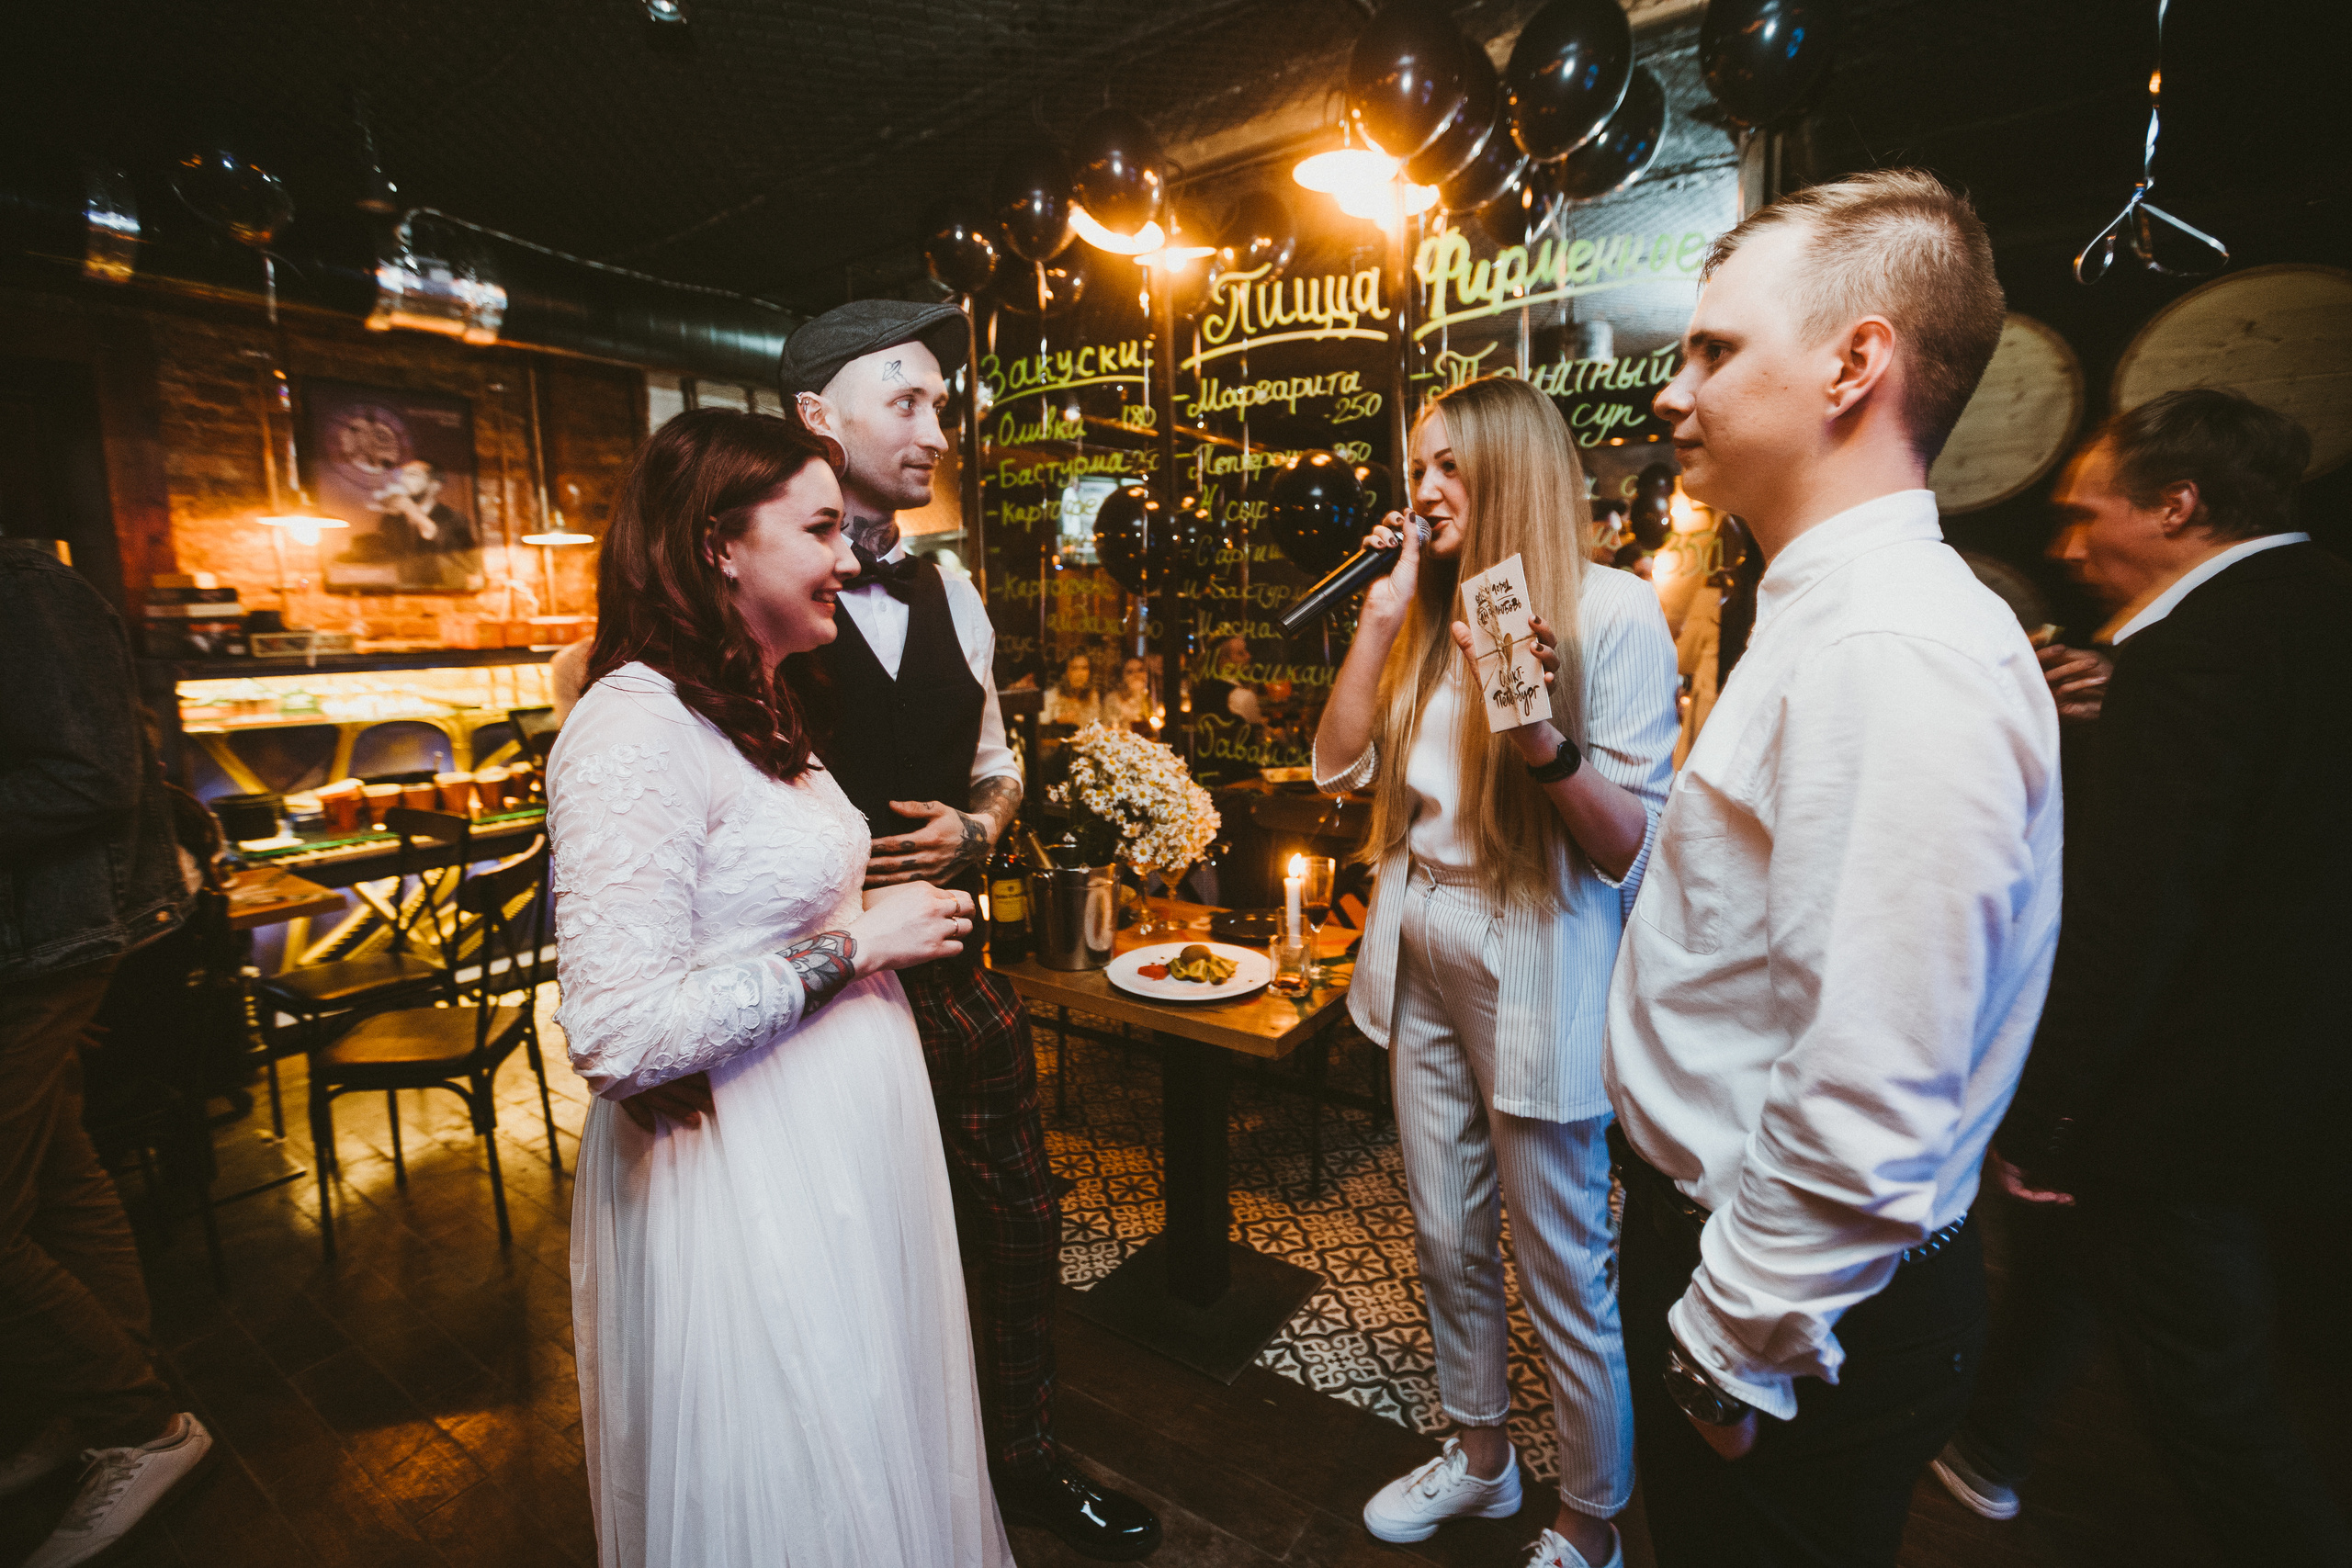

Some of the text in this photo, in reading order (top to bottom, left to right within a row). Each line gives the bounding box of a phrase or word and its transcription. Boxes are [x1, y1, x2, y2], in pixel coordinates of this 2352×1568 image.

[1413, 226, 1707, 320] Фирменное
[1204, 263, 1391, 344] Пицца
[1122, 404, 1159, 431] 180
[1570, 399, 1647, 449] суп
[1225, 500, 1269, 530] сыр
[1191, 646, 1339, 689] Мексикан
